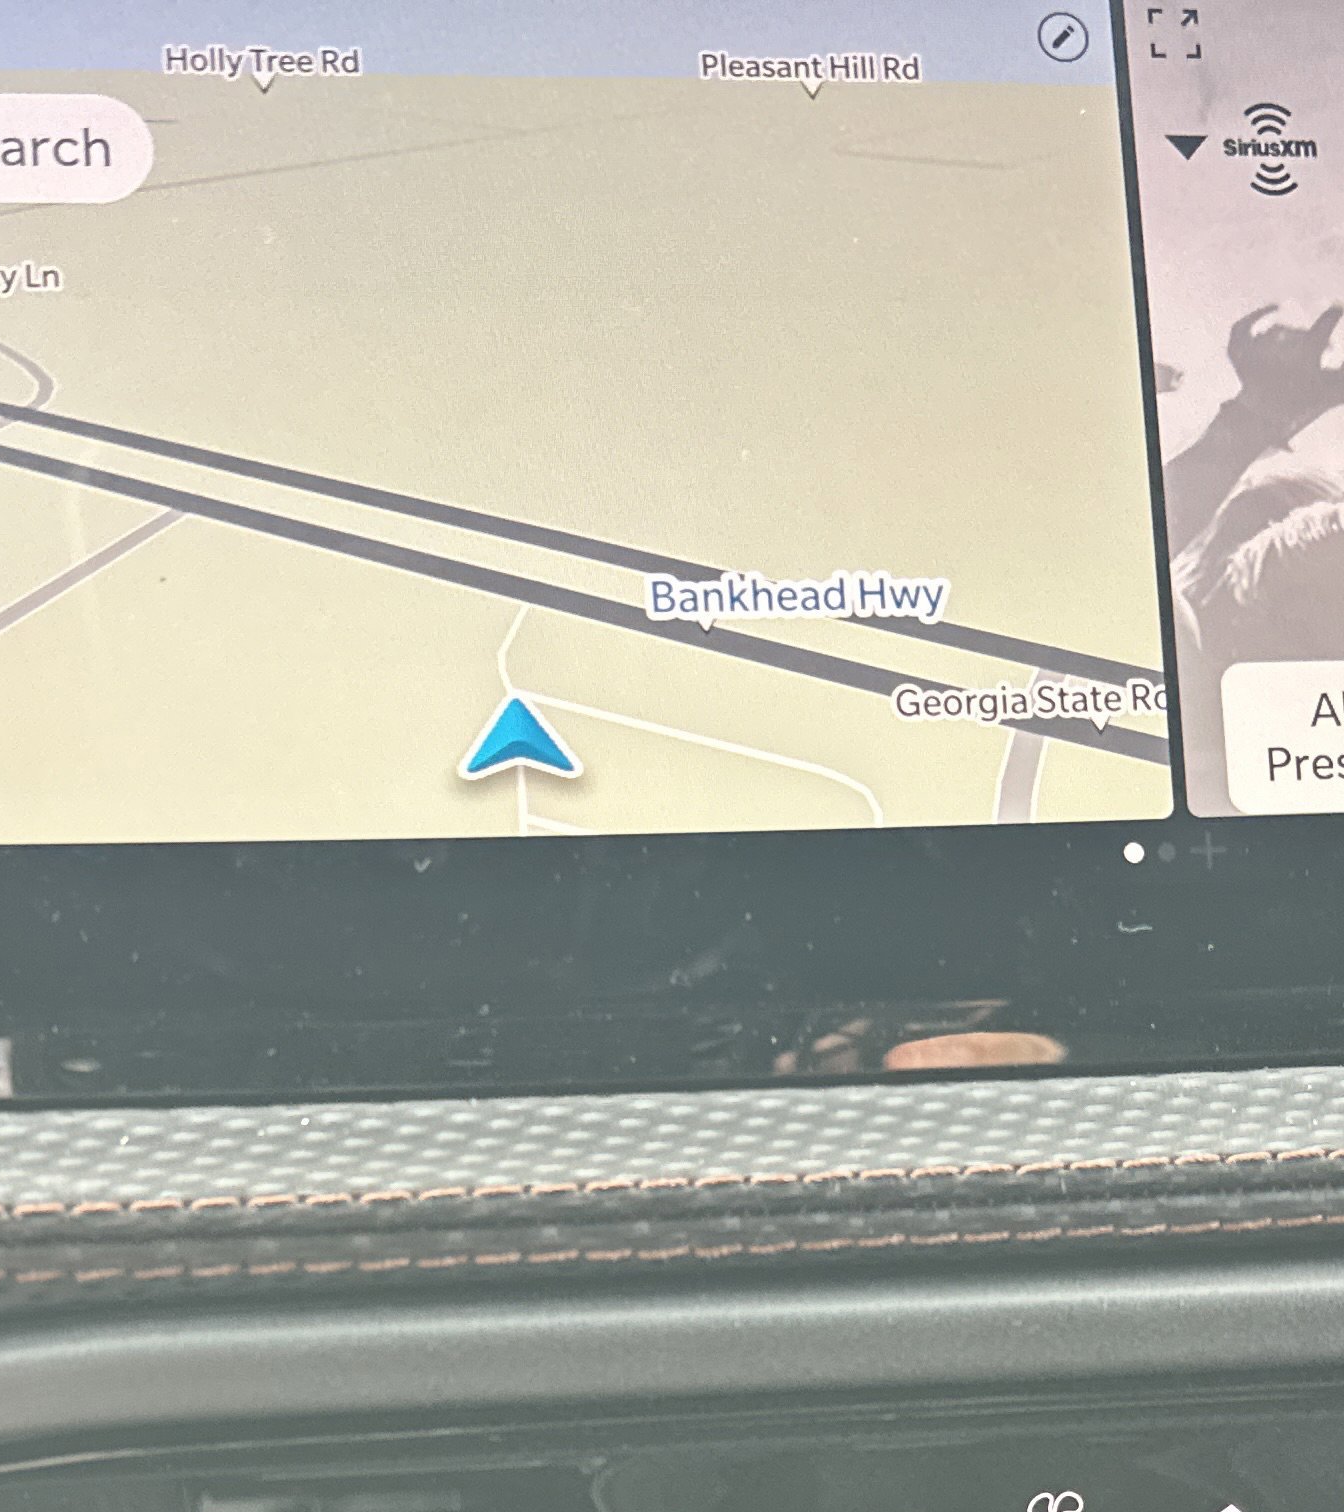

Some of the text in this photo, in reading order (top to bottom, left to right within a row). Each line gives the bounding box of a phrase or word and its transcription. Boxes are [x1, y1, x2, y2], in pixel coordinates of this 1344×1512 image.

[165, 46, 360, 76] Holly Tree Rd
[701, 53, 919, 81] Pleasant Hill Rd
[26, 264, 60, 290] Ln
[651, 578, 944, 617] Bankhead Hwy
[896, 686, 1028, 721] Georgia
[1037, 684, 1122, 713] State
